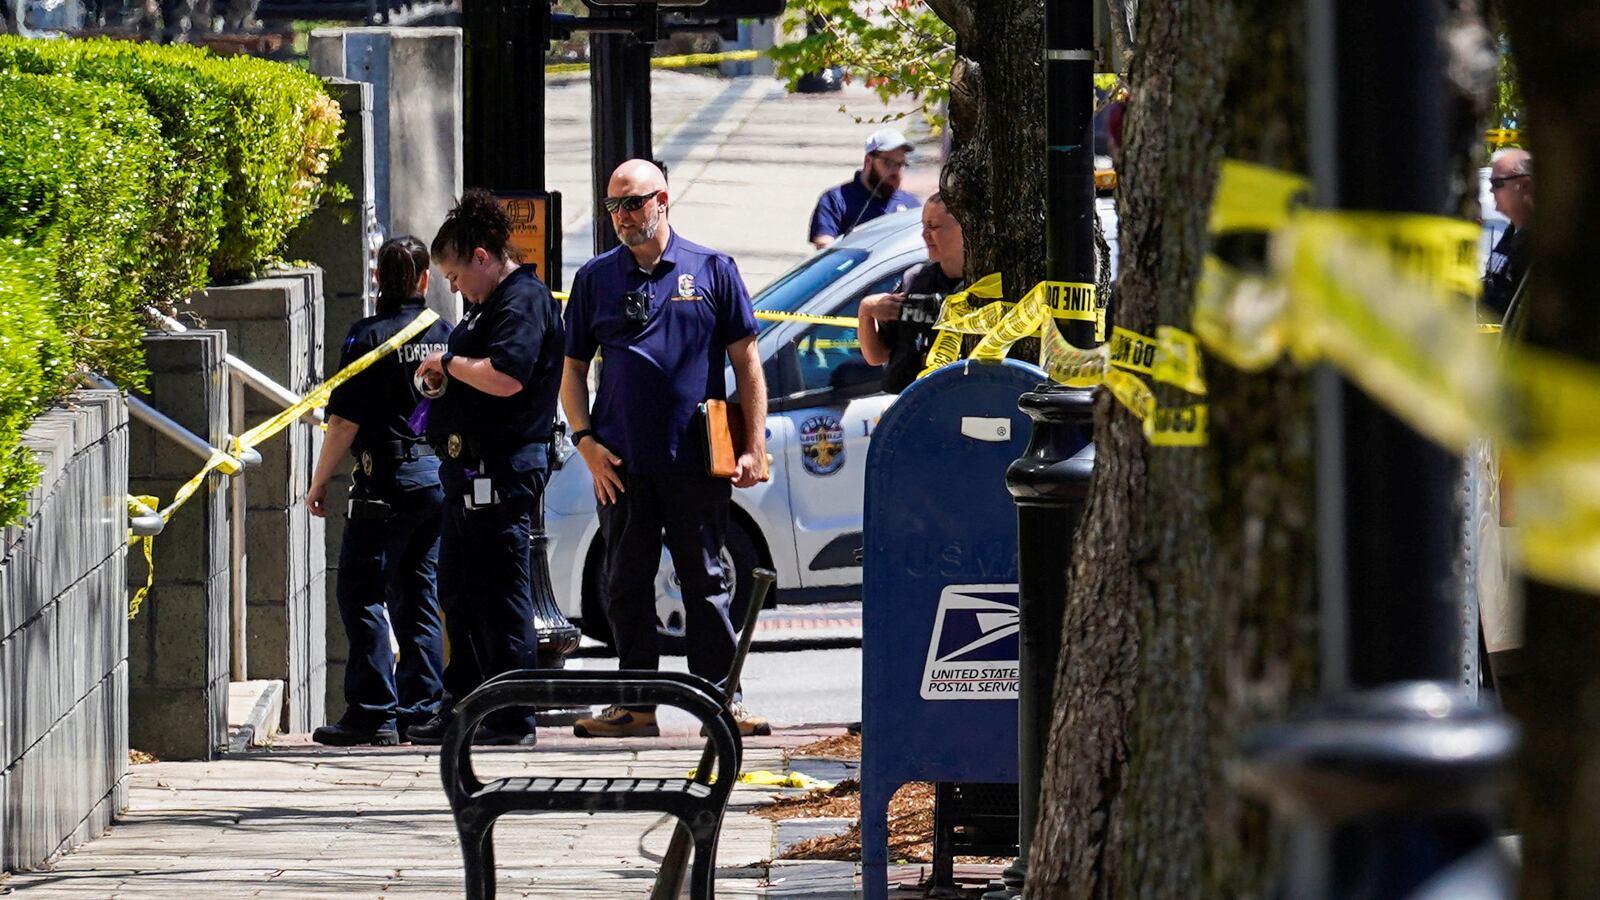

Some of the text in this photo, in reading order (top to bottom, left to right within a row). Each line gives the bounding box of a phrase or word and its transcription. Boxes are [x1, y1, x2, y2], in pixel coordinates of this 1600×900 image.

[1063, 286, 1092, 312] LINE
[901, 304, 935, 324] POL
[931, 668, 1020, 679] UNITED STATE
[928, 682, 1020, 692] POSTAL SERVIC
